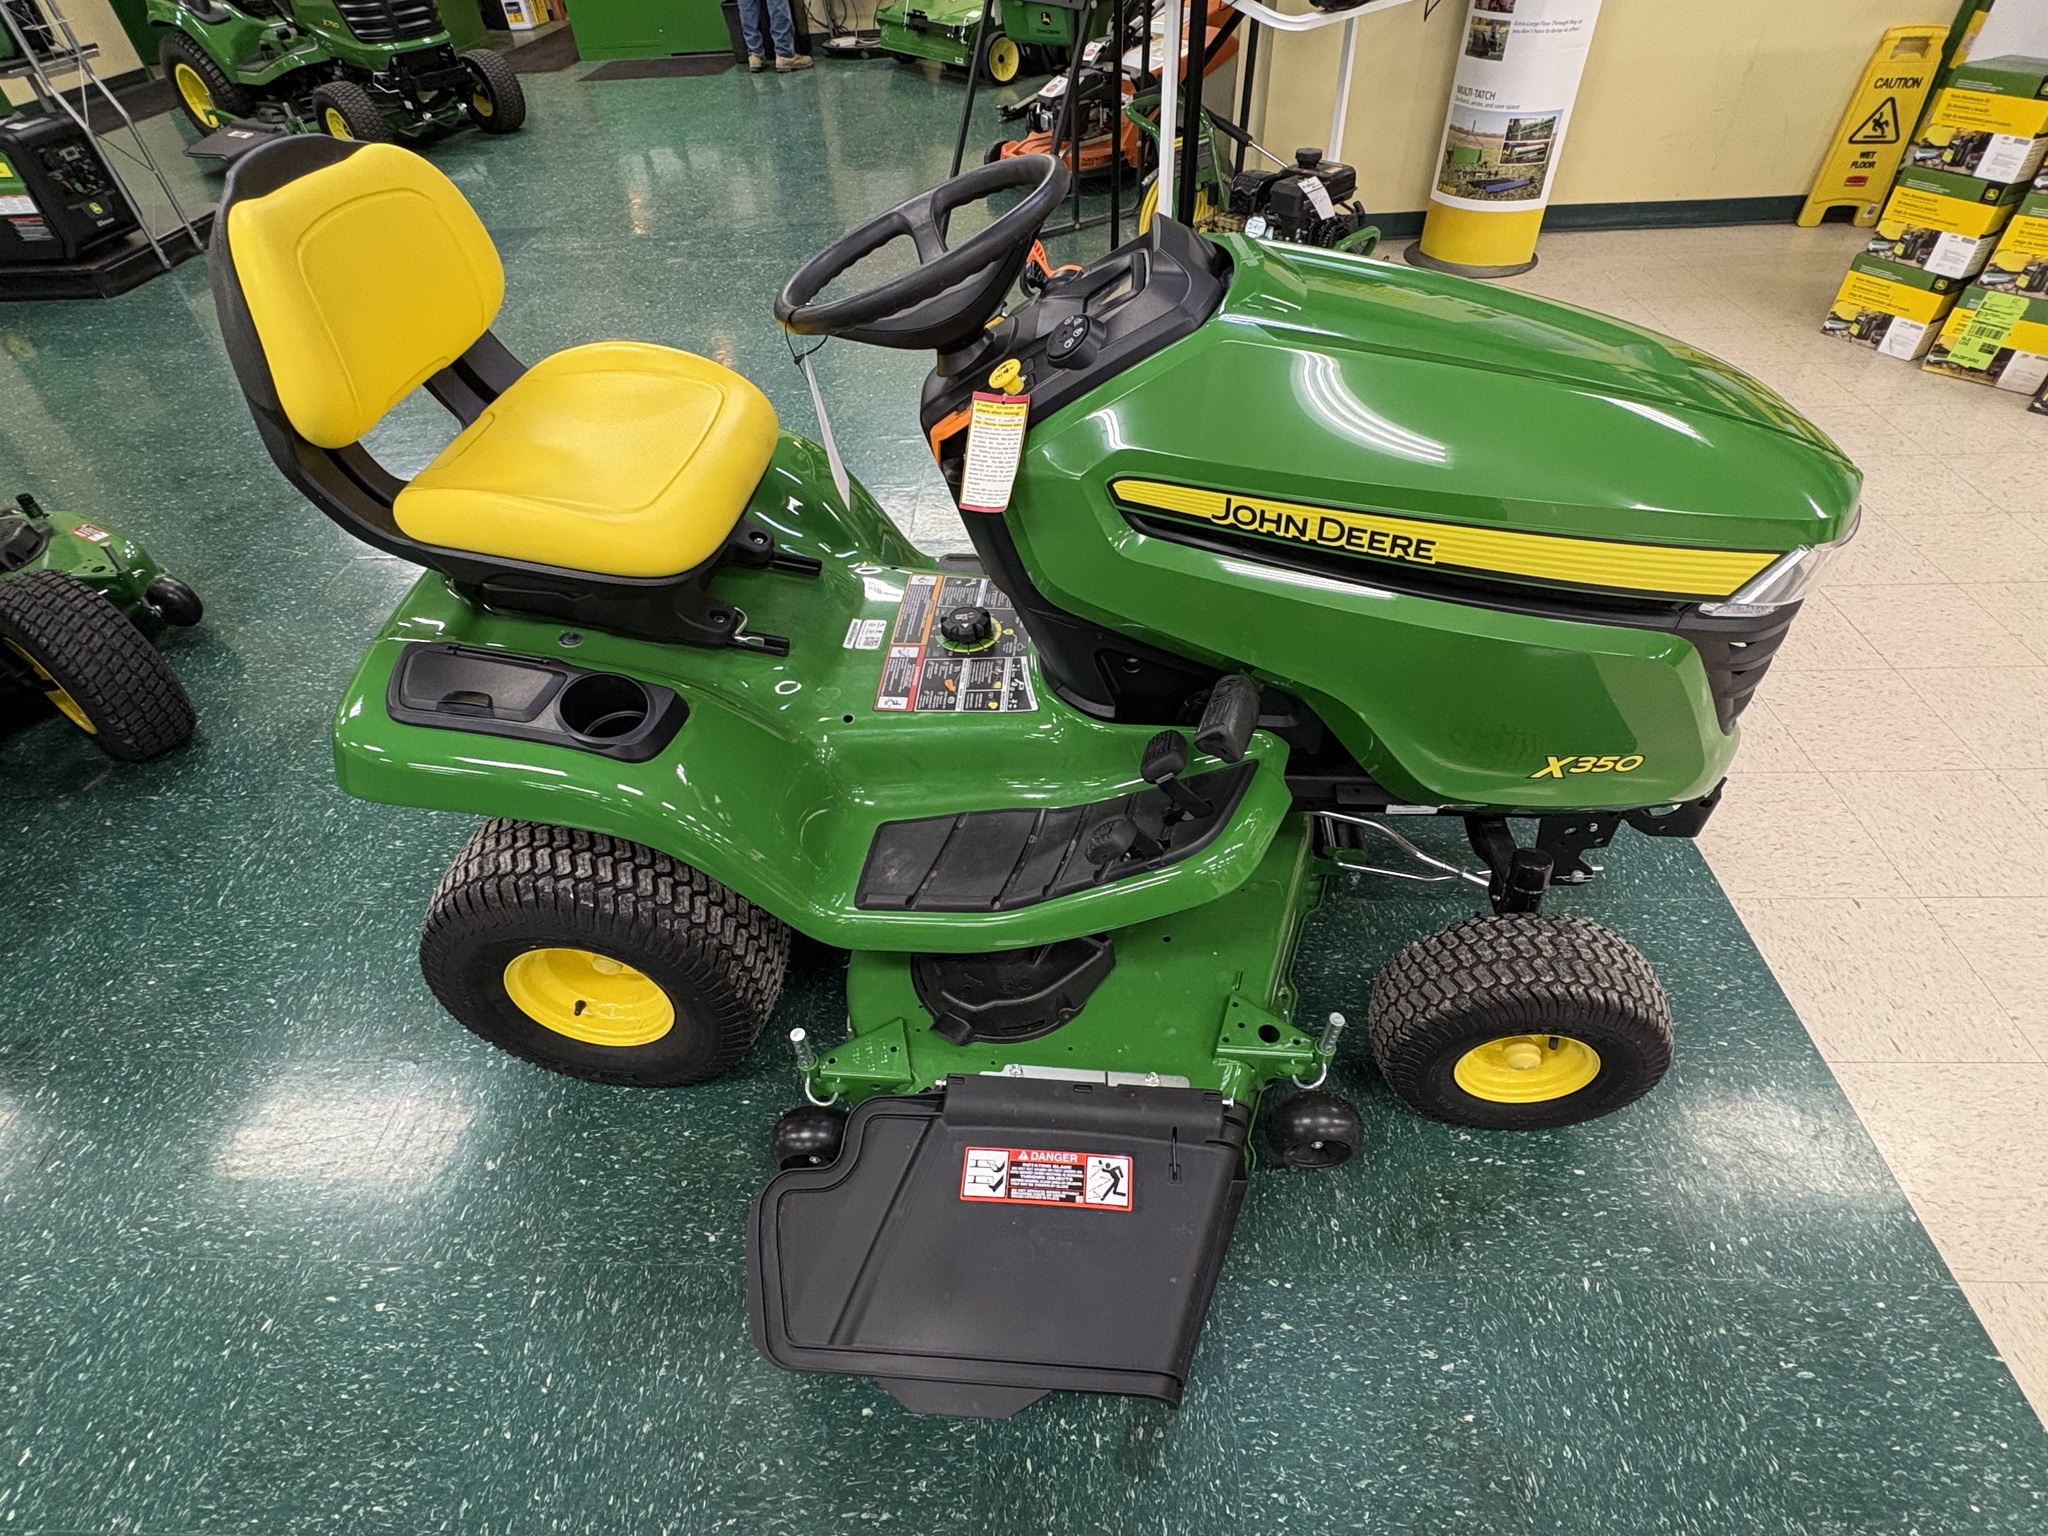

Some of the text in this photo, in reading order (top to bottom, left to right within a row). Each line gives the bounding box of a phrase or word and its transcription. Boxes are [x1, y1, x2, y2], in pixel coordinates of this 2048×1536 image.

[1874, 77, 1924, 90] CAUTION
[1456, 84, 1497, 101] MULTI-TATCH
[1859, 151, 1877, 159] WET
[1850, 161, 1876, 170] FLOOR
[1211, 497, 1437, 561] JOHN DEERE
[1526, 754, 1646, 779] X350
[1030, 1151, 1078, 1163] DANGER
